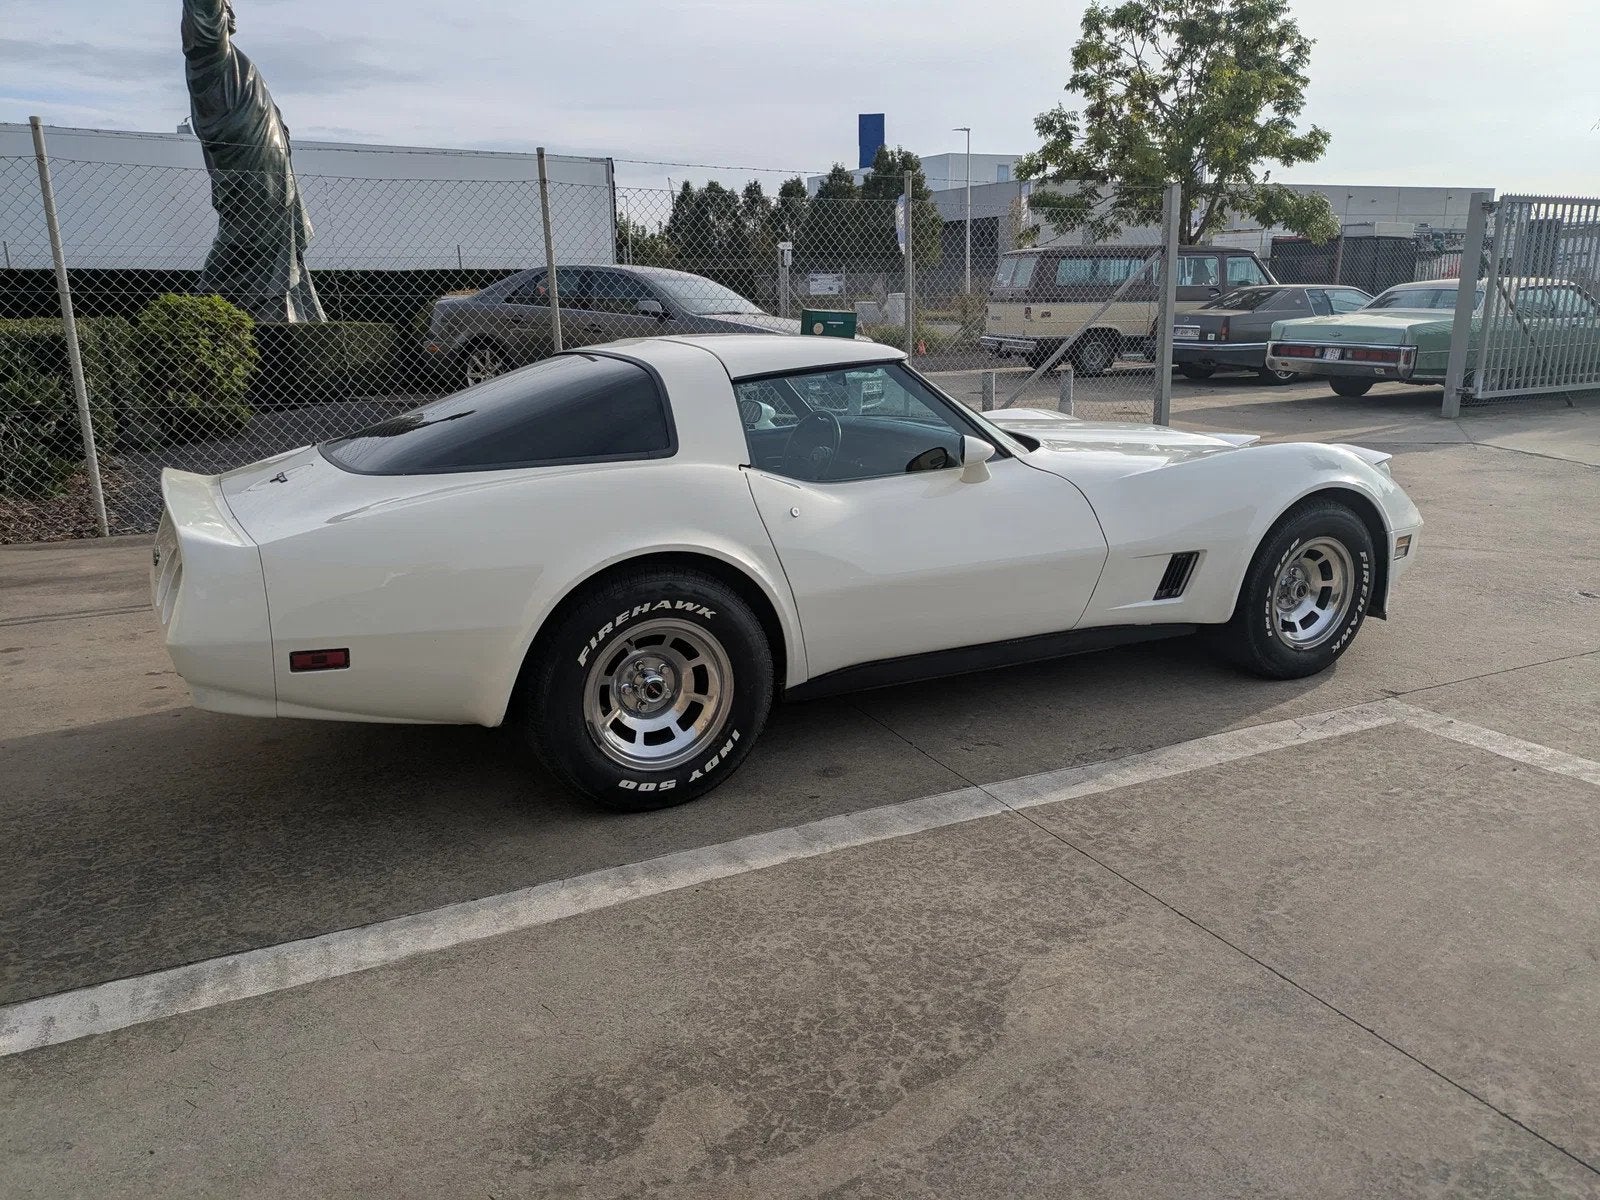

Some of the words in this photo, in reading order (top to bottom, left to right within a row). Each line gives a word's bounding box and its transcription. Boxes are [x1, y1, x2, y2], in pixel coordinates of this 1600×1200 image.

[1331, 551, 1370, 654] FIREHAWK
[577, 600, 717, 667] FIREHAWK
[618, 779, 677, 792] 500
[688, 729, 741, 783] INDY
